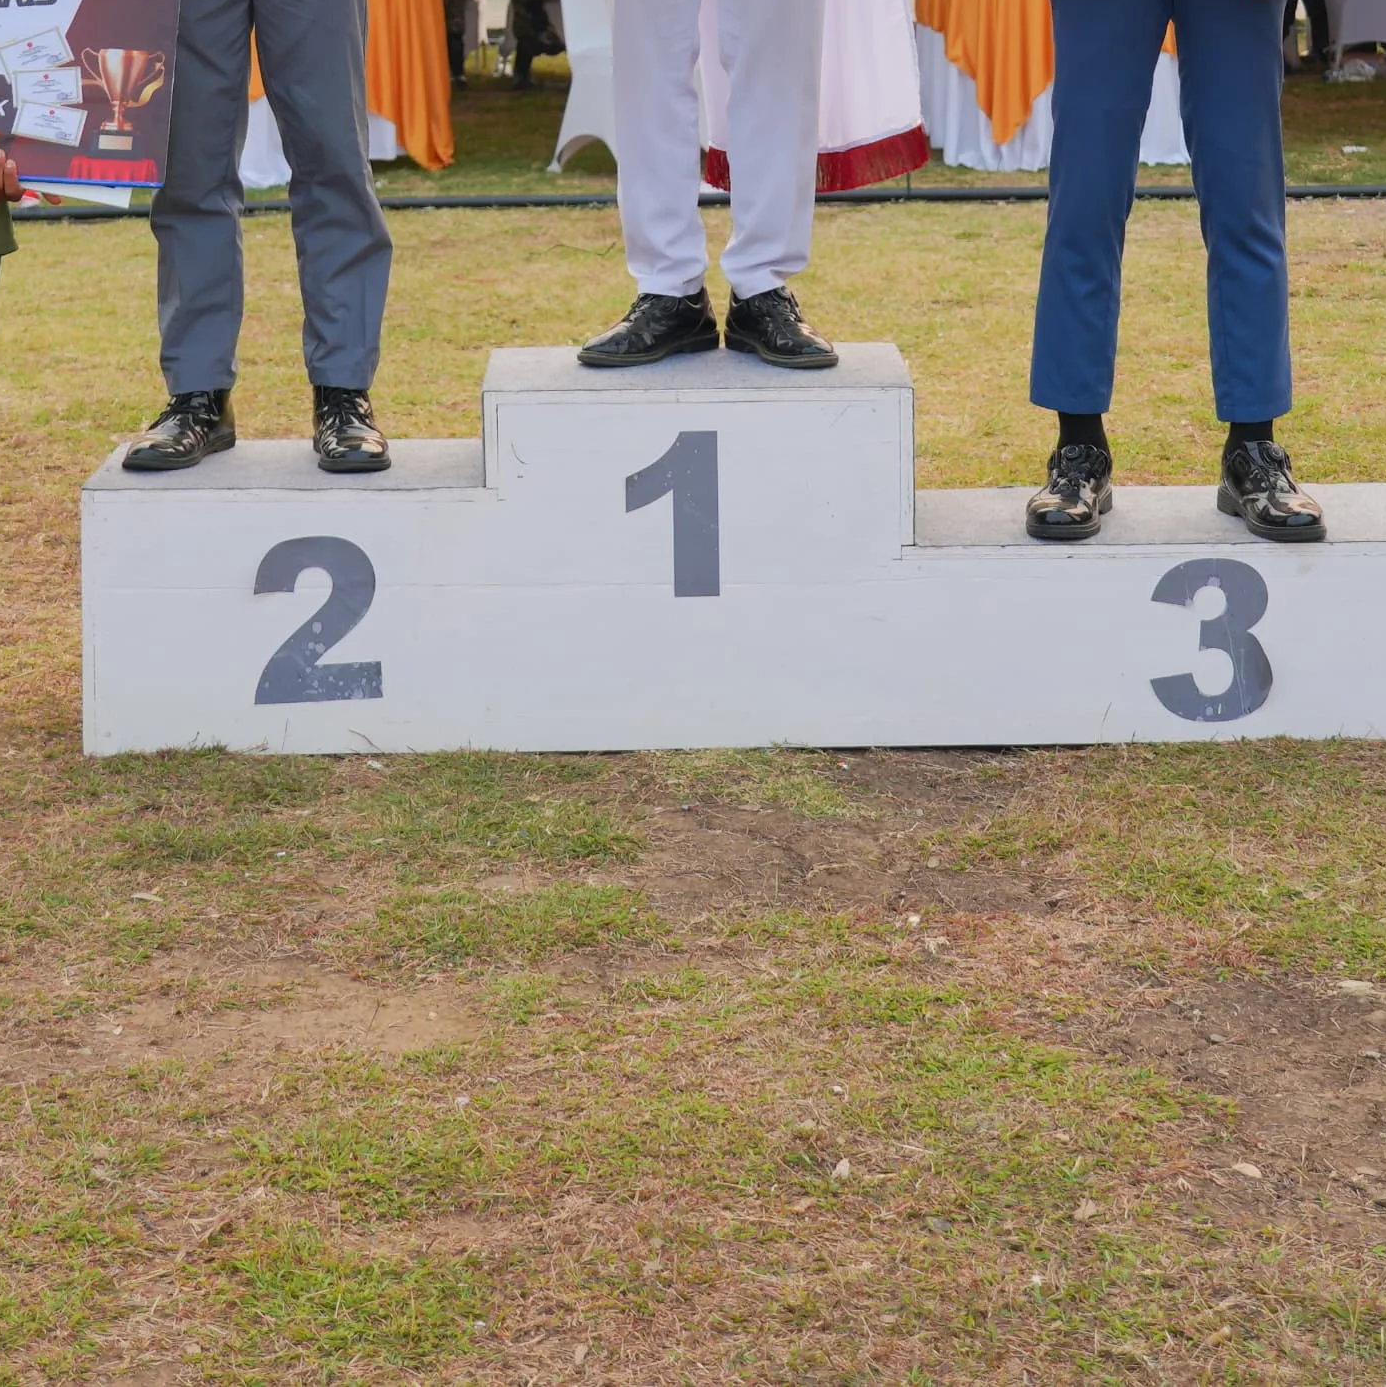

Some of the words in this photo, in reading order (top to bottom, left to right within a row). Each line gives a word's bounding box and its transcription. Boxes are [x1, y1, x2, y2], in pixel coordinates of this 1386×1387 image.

[626, 431, 720, 597] 1
[254, 536, 383, 704] 2
[1151, 558, 1274, 721] 3
